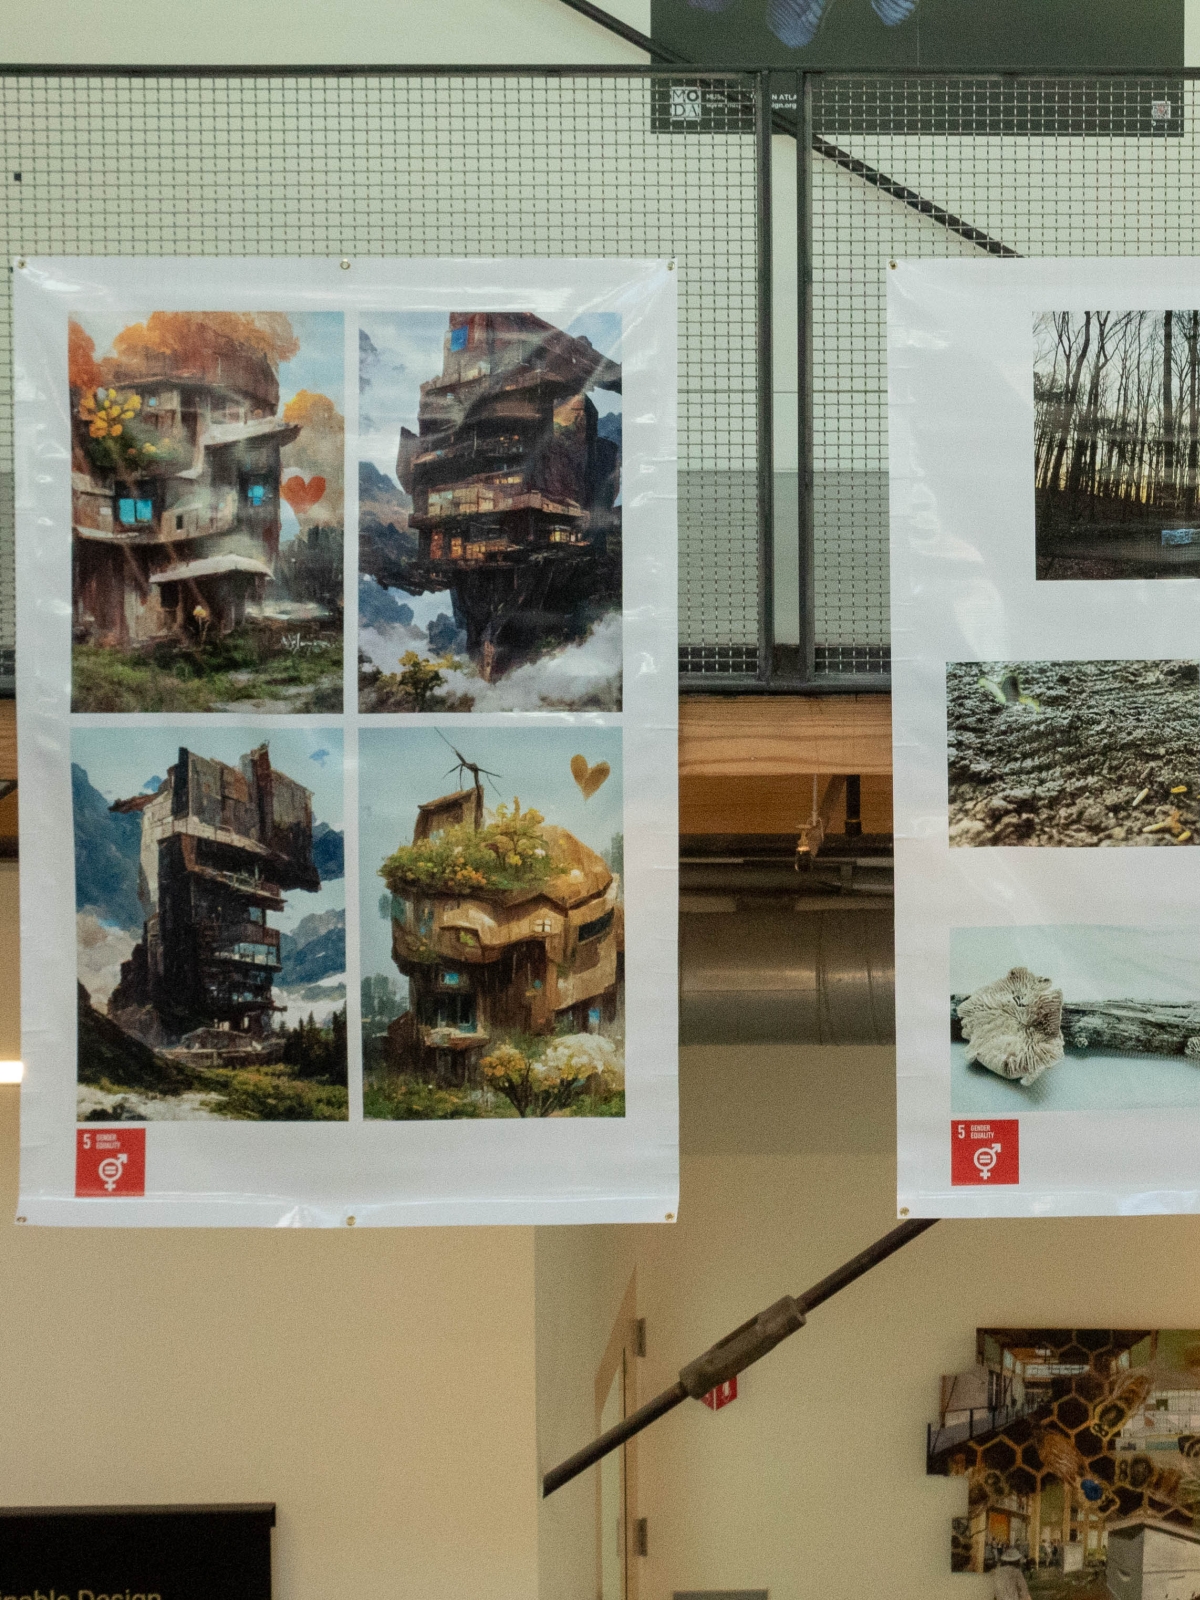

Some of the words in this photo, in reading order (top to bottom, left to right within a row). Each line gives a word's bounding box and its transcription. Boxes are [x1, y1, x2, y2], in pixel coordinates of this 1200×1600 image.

[958, 1124, 966, 1139] 5
[970, 1124, 991, 1132] GENDER
[970, 1131, 994, 1139] EQUALITY
[83, 1133, 91, 1149] 5
